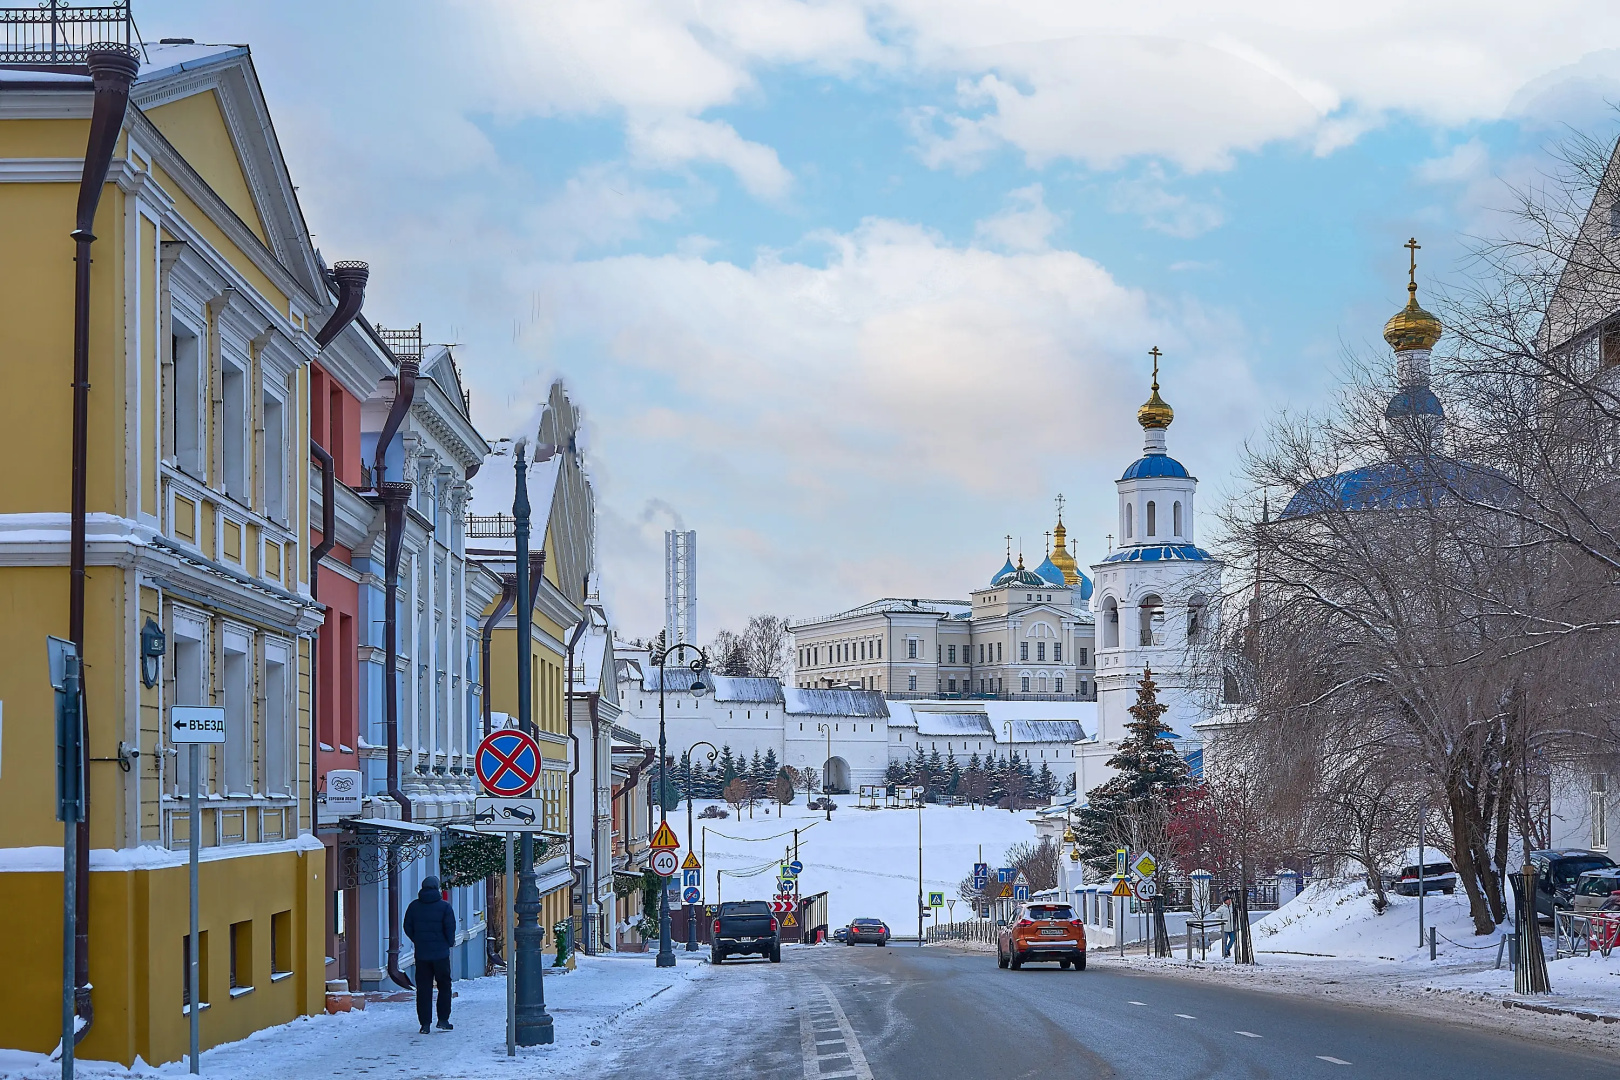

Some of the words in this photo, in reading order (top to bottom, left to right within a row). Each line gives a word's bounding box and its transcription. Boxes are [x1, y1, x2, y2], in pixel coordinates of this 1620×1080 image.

[190, 720, 223, 732] ВЪЕЗД
[657, 858, 673, 868] 40
[977, 878, 984, 888] P
[1140, 885, 1154, 894] 40
